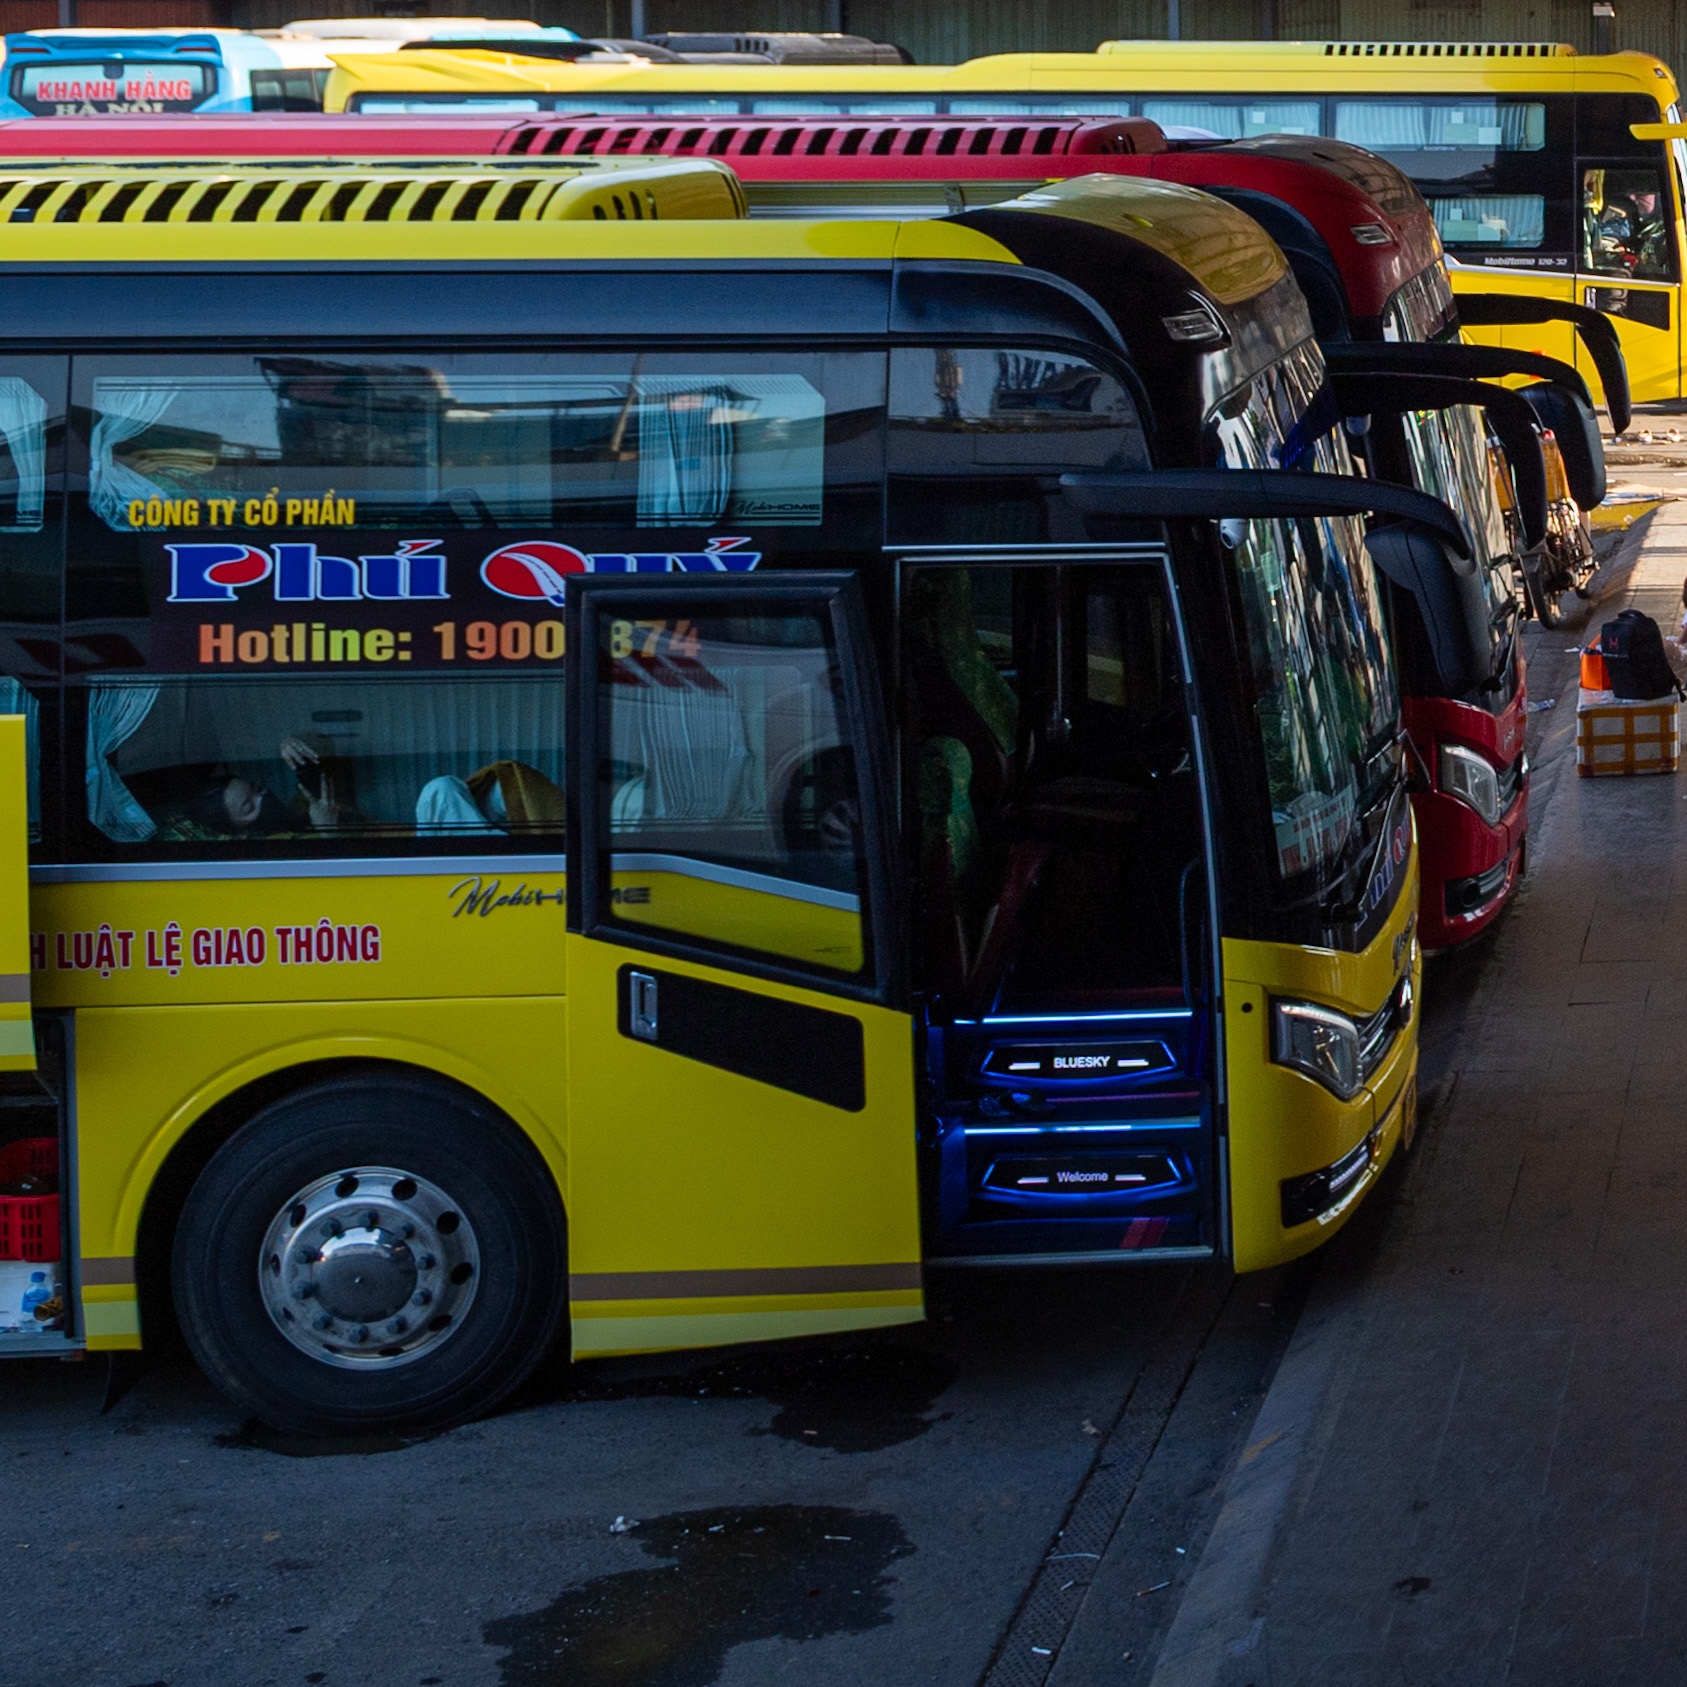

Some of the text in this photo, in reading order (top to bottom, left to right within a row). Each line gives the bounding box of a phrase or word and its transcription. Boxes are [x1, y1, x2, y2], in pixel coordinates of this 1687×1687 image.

[37, 80, 117, 101] KHANH
[128, 486, 355, 527] CÔNG TY CỔ PHẦN
[163, 539, 451, 603] Phú
[199, 622, 413, 663] Hotline:
[432, 620, 566, 661] 1900
[55, 922, 134, 979] LUẬT
[146, 920, 183, 977] LỆ
[191, 926, 267, 967] GIAO
[275, 917, 381, 965] THÔNG
[1053, 1056, 1111, 1069] BLUESKY
[1056, 1171, 1109, 1183] Welcome
